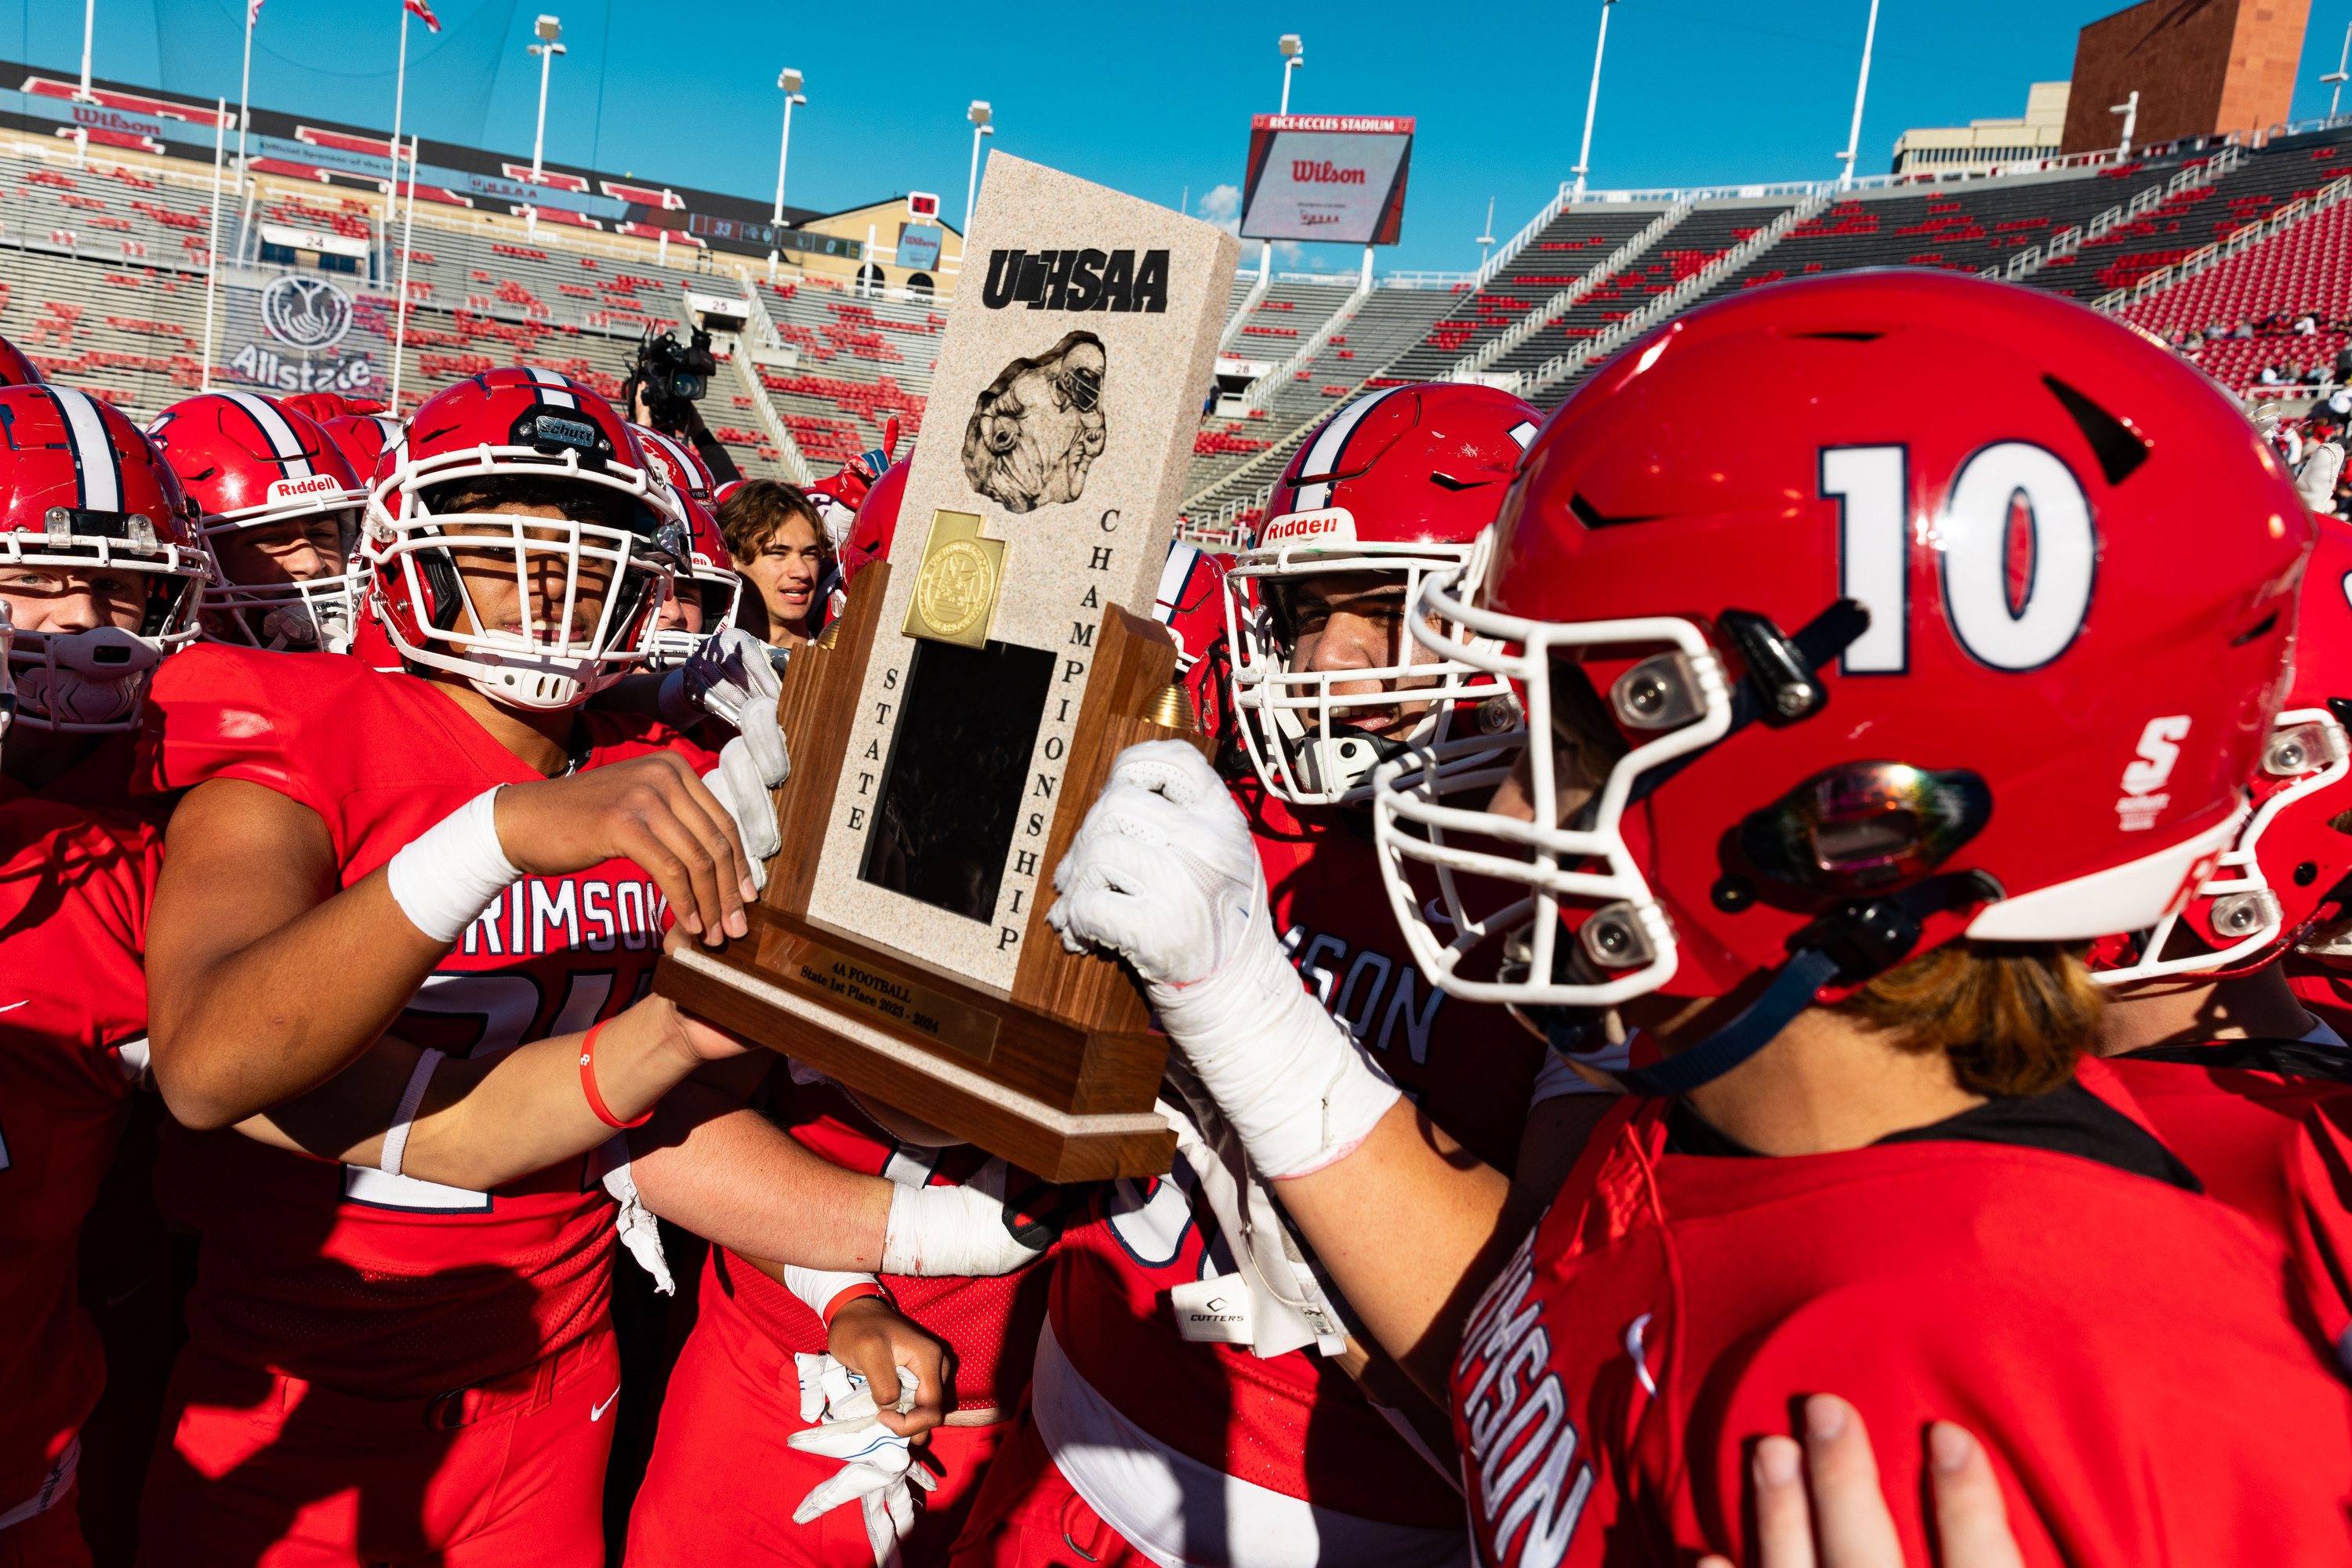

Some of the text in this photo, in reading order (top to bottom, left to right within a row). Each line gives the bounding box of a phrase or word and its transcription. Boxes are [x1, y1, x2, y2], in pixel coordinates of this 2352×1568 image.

[72, 106, 162, 136] Wilson
[1269, 117, 1395, 132] RICE-ECCLES STADIUM
[1291, 160, 1367, 185] Wilson
[714, 222, 732, 237] 33
[982, 249, 1170, 313] UHSAA
[713, 300, 728, 311] 25
[230, 343, 372, 393] Allstate
[1236, 364, 1250, 374] 28
[277, 477, 335, 496] Riddell
[1268, 517, 1338, 541] Riddell
[1817, 440, 2099, 677] 10
[832, 961, 912, 1004] 4A FOOTBALL
[800, 964, 828, 987] State
[829, 978, 846, 995] 1st
[846, 984, 877, 1007] Place
[877, 997, 905, 1019] 2023
[912, 1012, 939, 1034] 2024
[1190, 1314, 1245, 1323] CUTTERS
